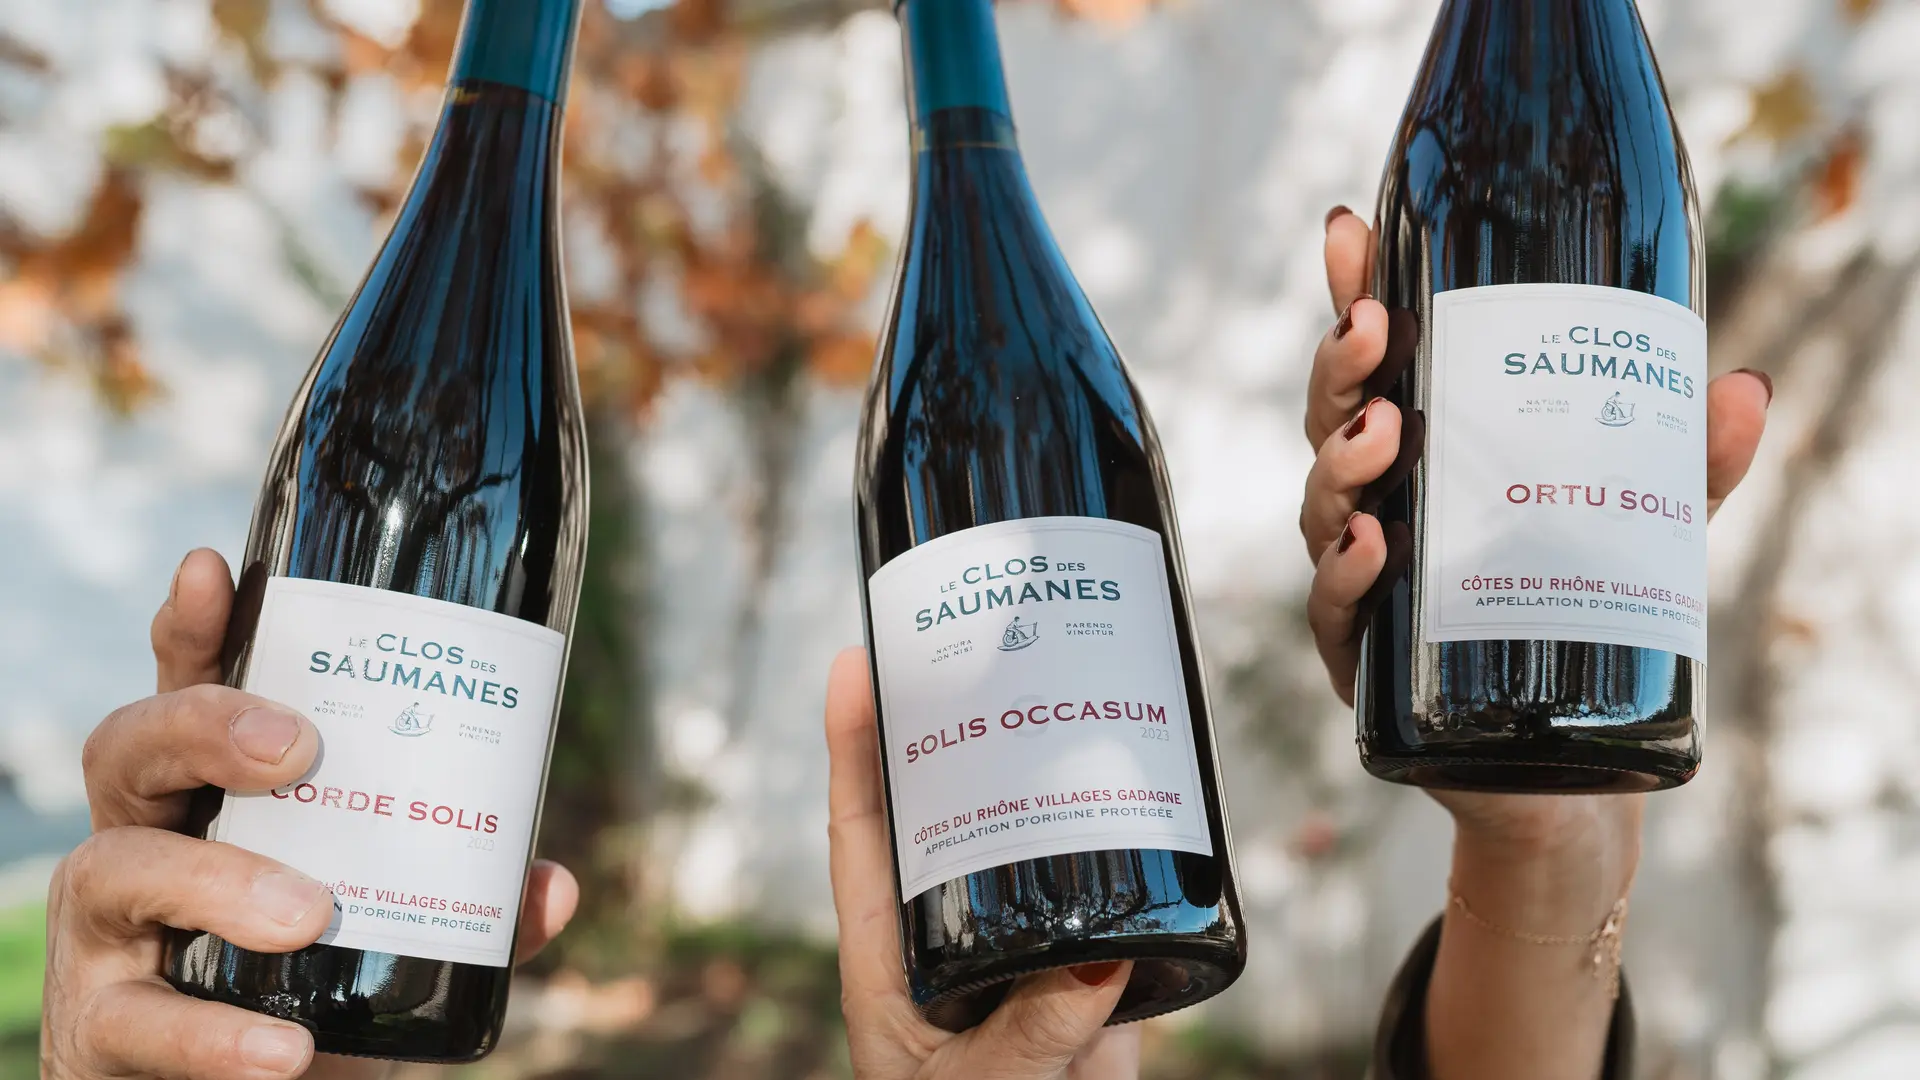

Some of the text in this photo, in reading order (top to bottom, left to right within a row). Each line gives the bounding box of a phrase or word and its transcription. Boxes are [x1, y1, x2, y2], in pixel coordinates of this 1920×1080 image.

[1541, 326, 1677, 362] LE CLOS DES
[1504, 352, 1694, 399] SAUMANES
[1506, 484, 1692, 525] ORTU SOLIS
[940, 555, 1086, 594] LE CLOS DES
[1461, 575, 1514, 592] CÔTES
[1520, 577, 1543, 591] DU
[1550, 576, 1605, 593] RHÔNE
[1611, 581, 1672, 603] VILLAGES
[915, 579, 1121, 632] SAUMANES
[1475, 596, 1583, 608] APPELLATION
[1589, 599, 1658, 616] D'ORIGINE
[1065, 622, 1113, 630] PARENDO
[1066, 629, 1114, 637] VINCITUR
[348, 633, 497, 673] LE CLOS DES
[930, 646, 974, 665] NON NISI
[936, 639, 973, 655] NATURA
[309, 650, 519, 709] SAUMANES
[314, 706, 336, 715] NON
[458, 731, 501, 745] VINCITUR
[459, 723, 502, 738] PARENDO
[906, 717, 988, 764] SOLIS
[1000, 701, 1168, 730] OCCASUM
[1139, 726, 1170, 742] 2023
[408, 801, 499, 833] SOLIS
[914, 789, 1182, 845] CÔTES DU RHÔNE VILLAGES GADAGNE
[925, 805, 1174, 857] APPELLATION D'ORIGINE PROTÉGÉE
[467, 836, 496, 852] 2023
[349, 904, 426, 924] D'ORIGINE
[431, 917, 492, 934] PROTÉGÉE
[375, 889, 447, 911] VILLAGES
[451, 901, 503, 919] GADAGNE
